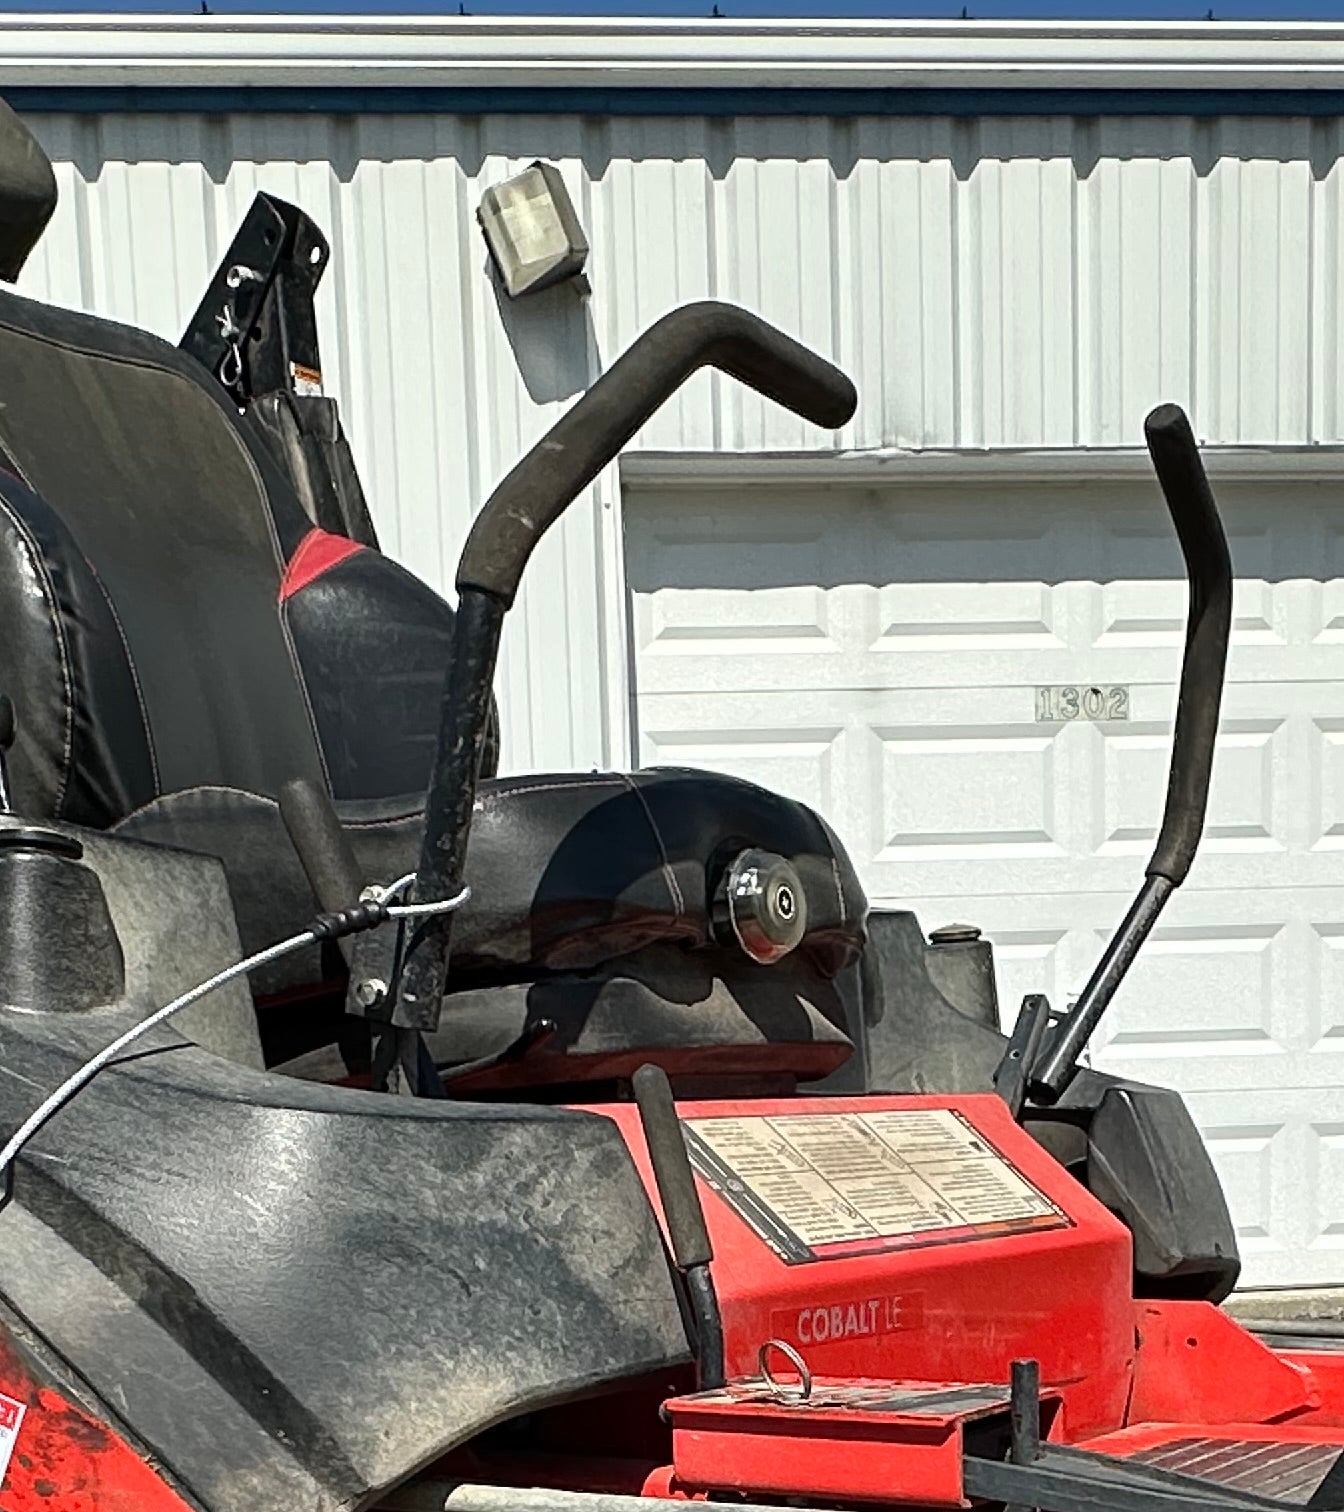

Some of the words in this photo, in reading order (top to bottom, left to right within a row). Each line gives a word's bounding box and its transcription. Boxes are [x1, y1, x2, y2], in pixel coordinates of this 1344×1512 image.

[1040, 686, 1128, 720] 1302
[798, 1300, 880, 1344] COBALT
[884, 1296, 904, 1330] LE
